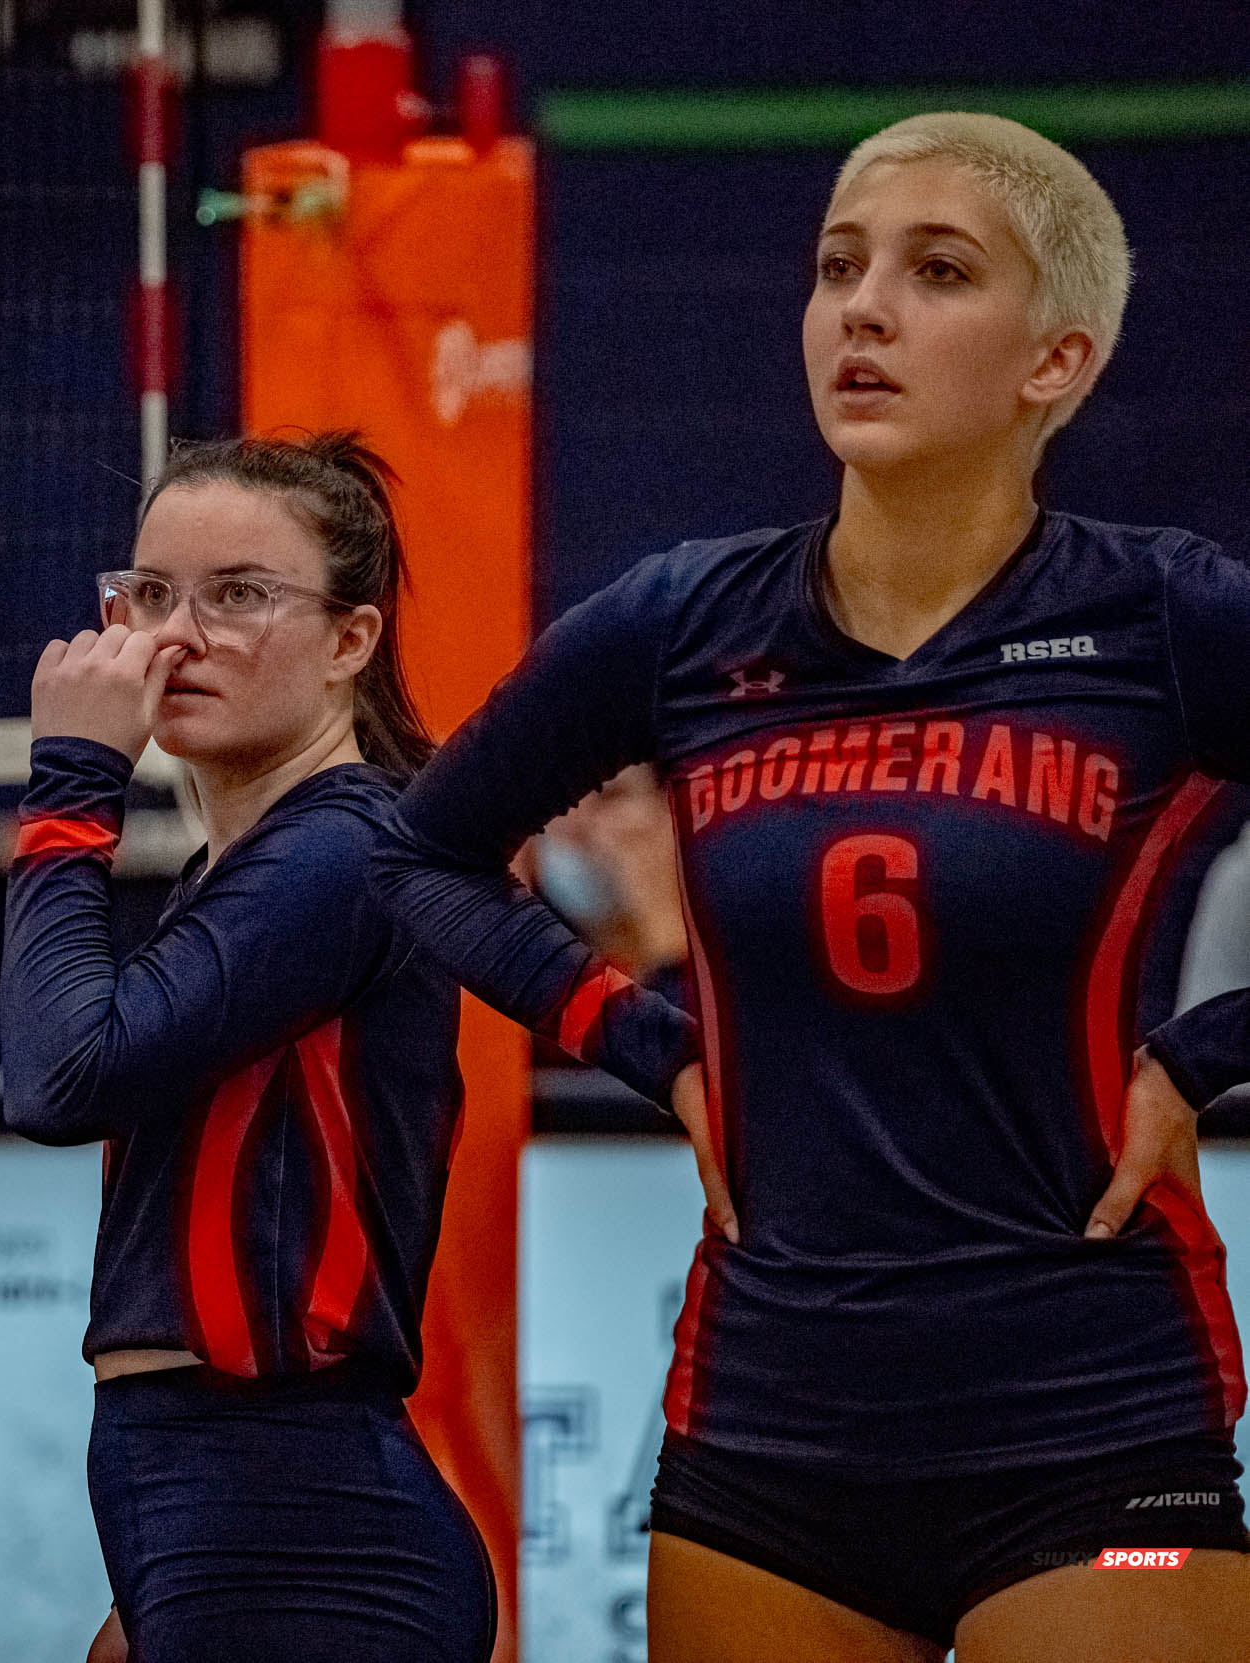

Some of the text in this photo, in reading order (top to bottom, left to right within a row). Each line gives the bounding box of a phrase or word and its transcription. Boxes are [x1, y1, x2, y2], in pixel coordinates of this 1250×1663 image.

[1000, 635, 1097, 663] RSEQ
[687, 720, 1119, 842] BOOMERANG
[821, 834, 922, 994] 6
